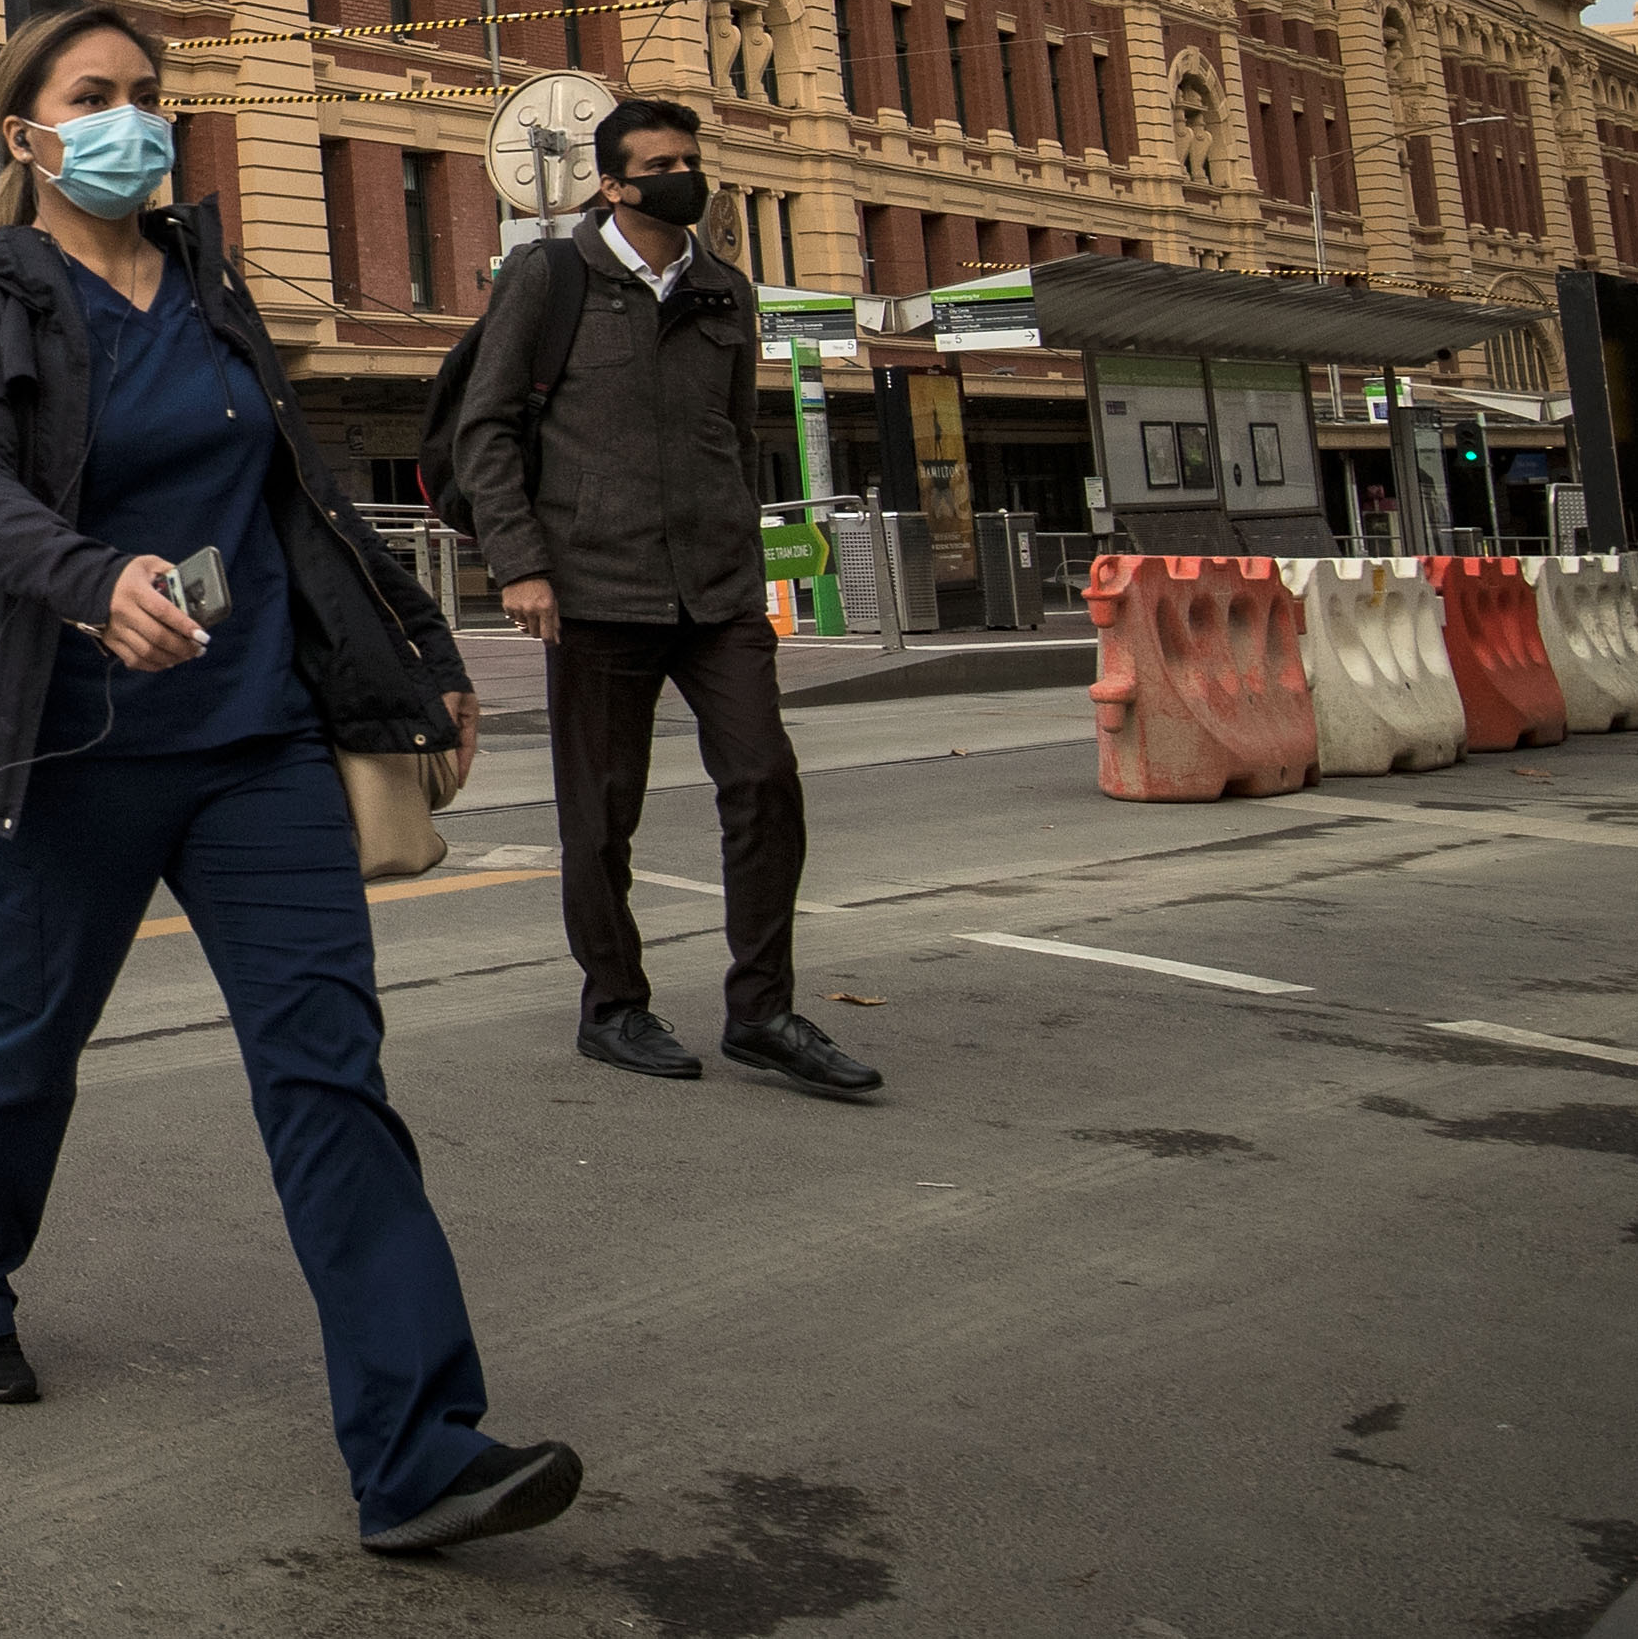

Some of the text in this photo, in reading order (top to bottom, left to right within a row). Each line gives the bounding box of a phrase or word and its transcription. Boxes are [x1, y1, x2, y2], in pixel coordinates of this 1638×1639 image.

[955, 334, 963, 344] 5
[847, 340, 855, 350] 5
[776, 547, 792, 559] TRAM
